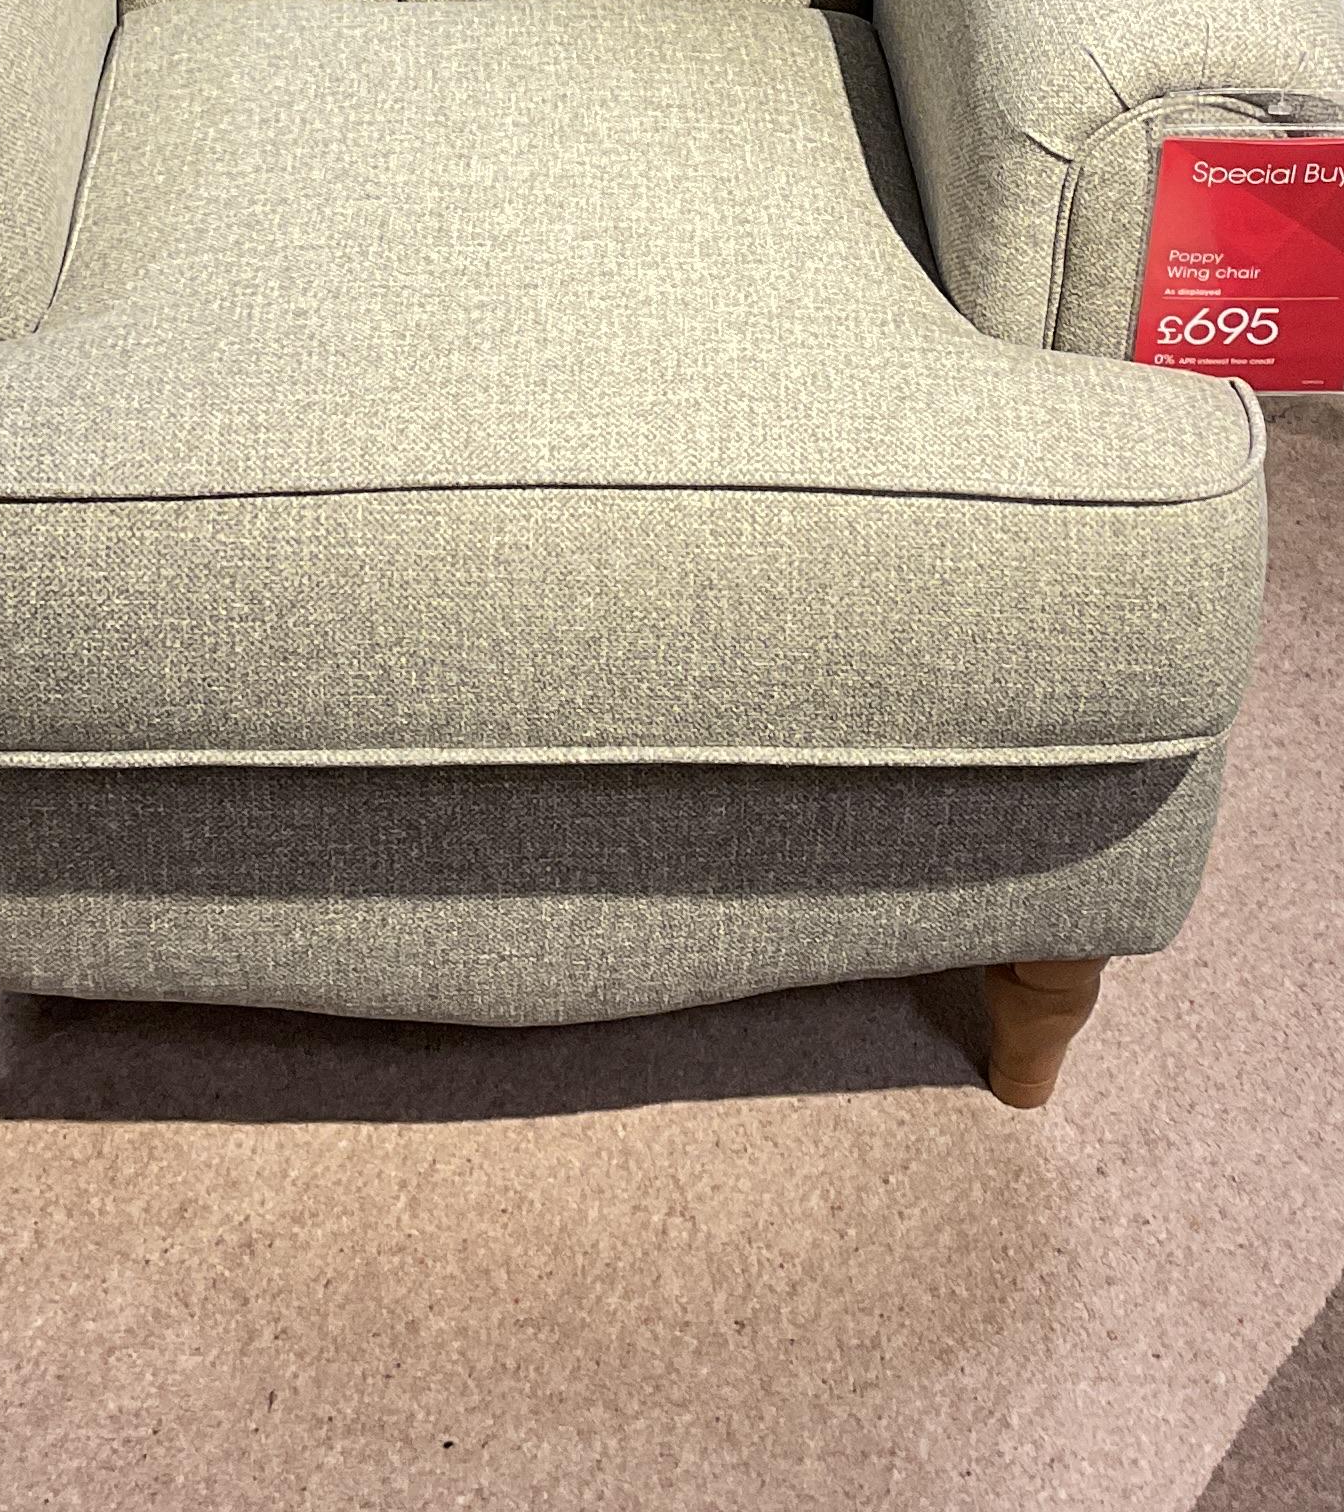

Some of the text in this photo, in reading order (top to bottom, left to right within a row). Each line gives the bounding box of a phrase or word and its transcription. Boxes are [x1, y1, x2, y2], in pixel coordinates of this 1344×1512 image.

[1192, 160, 1298, 188] Special
[1168, 249, 1225, 265] Poppy
[1166, 265, 1262, 282] Wing chair
[1177, 287, 1222, 298] displayed
[1156, 306, 1280, 346] £695
[1153, 353, 1176, 366] 0%
[1230, 355, 1249, 366] free
[1248, 355, 1276, 366] credit
